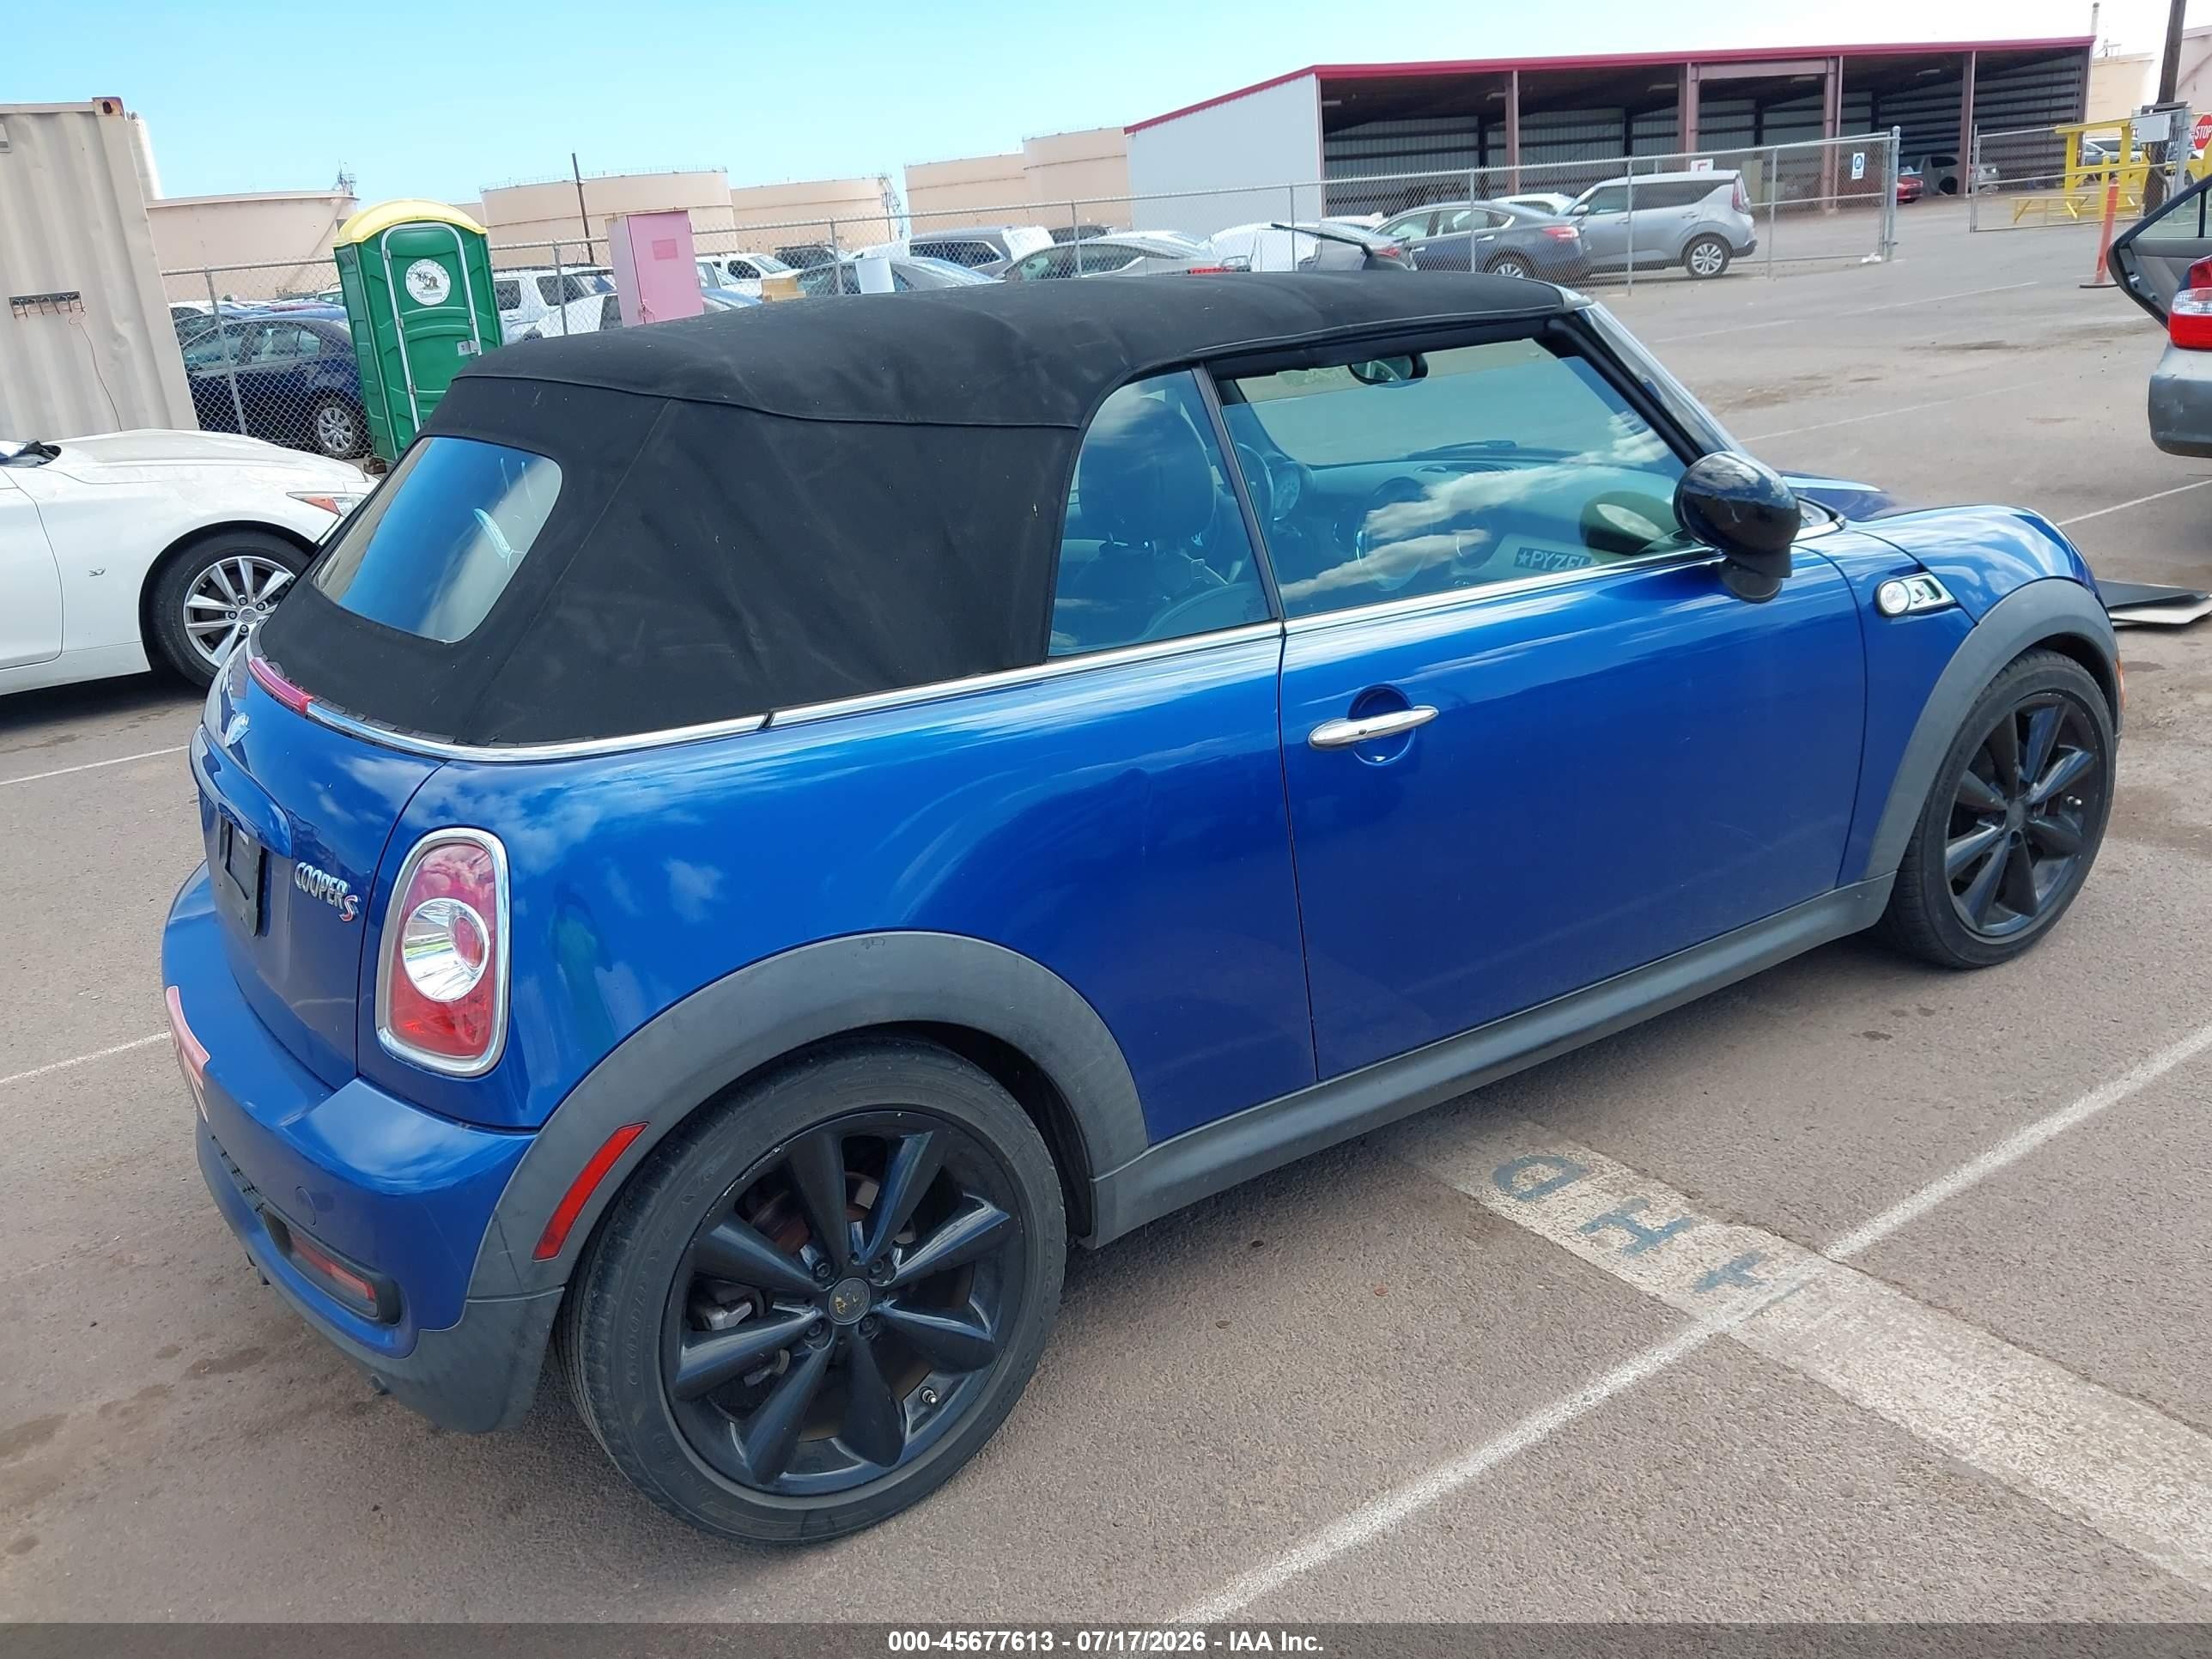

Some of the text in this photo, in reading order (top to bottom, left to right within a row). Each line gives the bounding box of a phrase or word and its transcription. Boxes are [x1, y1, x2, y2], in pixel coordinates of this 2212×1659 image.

[2194, 125, 2212, 140] STOP
[294, 861, 358, 922] COOPER S
